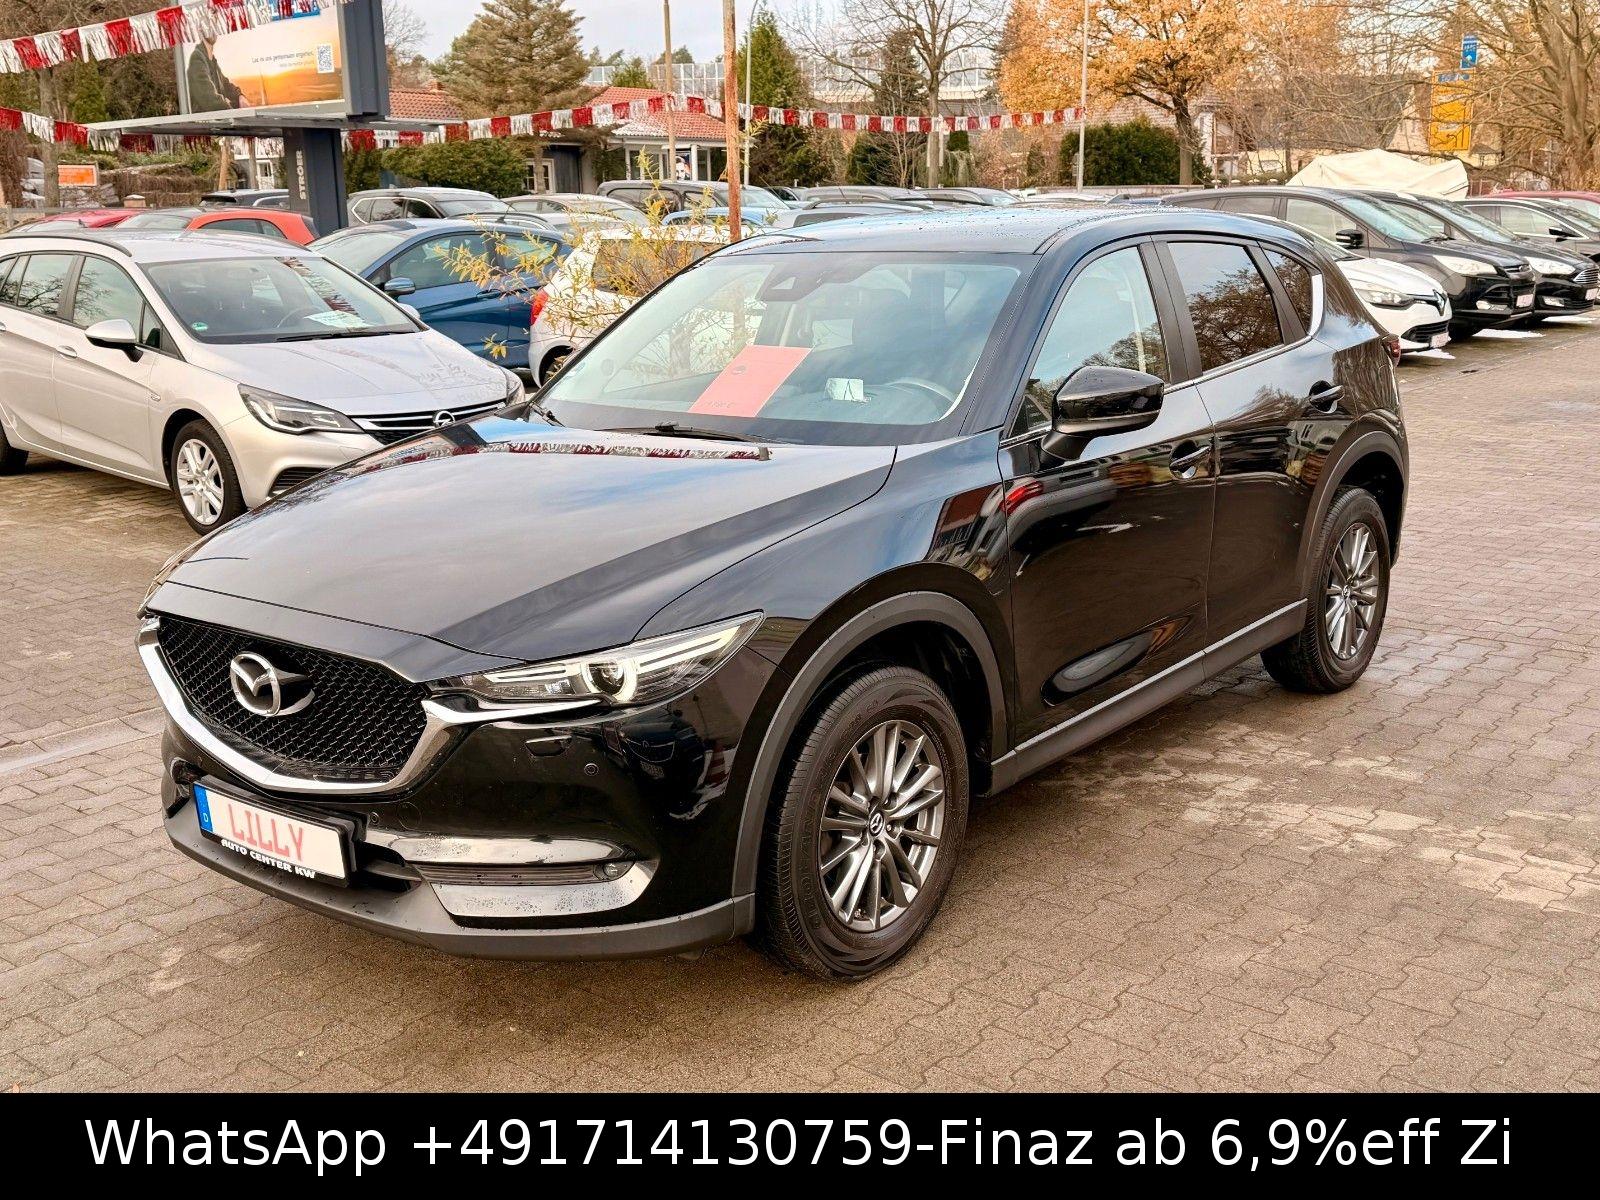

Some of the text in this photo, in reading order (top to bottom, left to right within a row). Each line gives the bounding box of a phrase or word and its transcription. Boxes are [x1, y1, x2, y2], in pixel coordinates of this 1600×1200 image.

[228, 803, 305, 862] LILLY
[221, 839, 316, 879] AUTO CENTER KW
